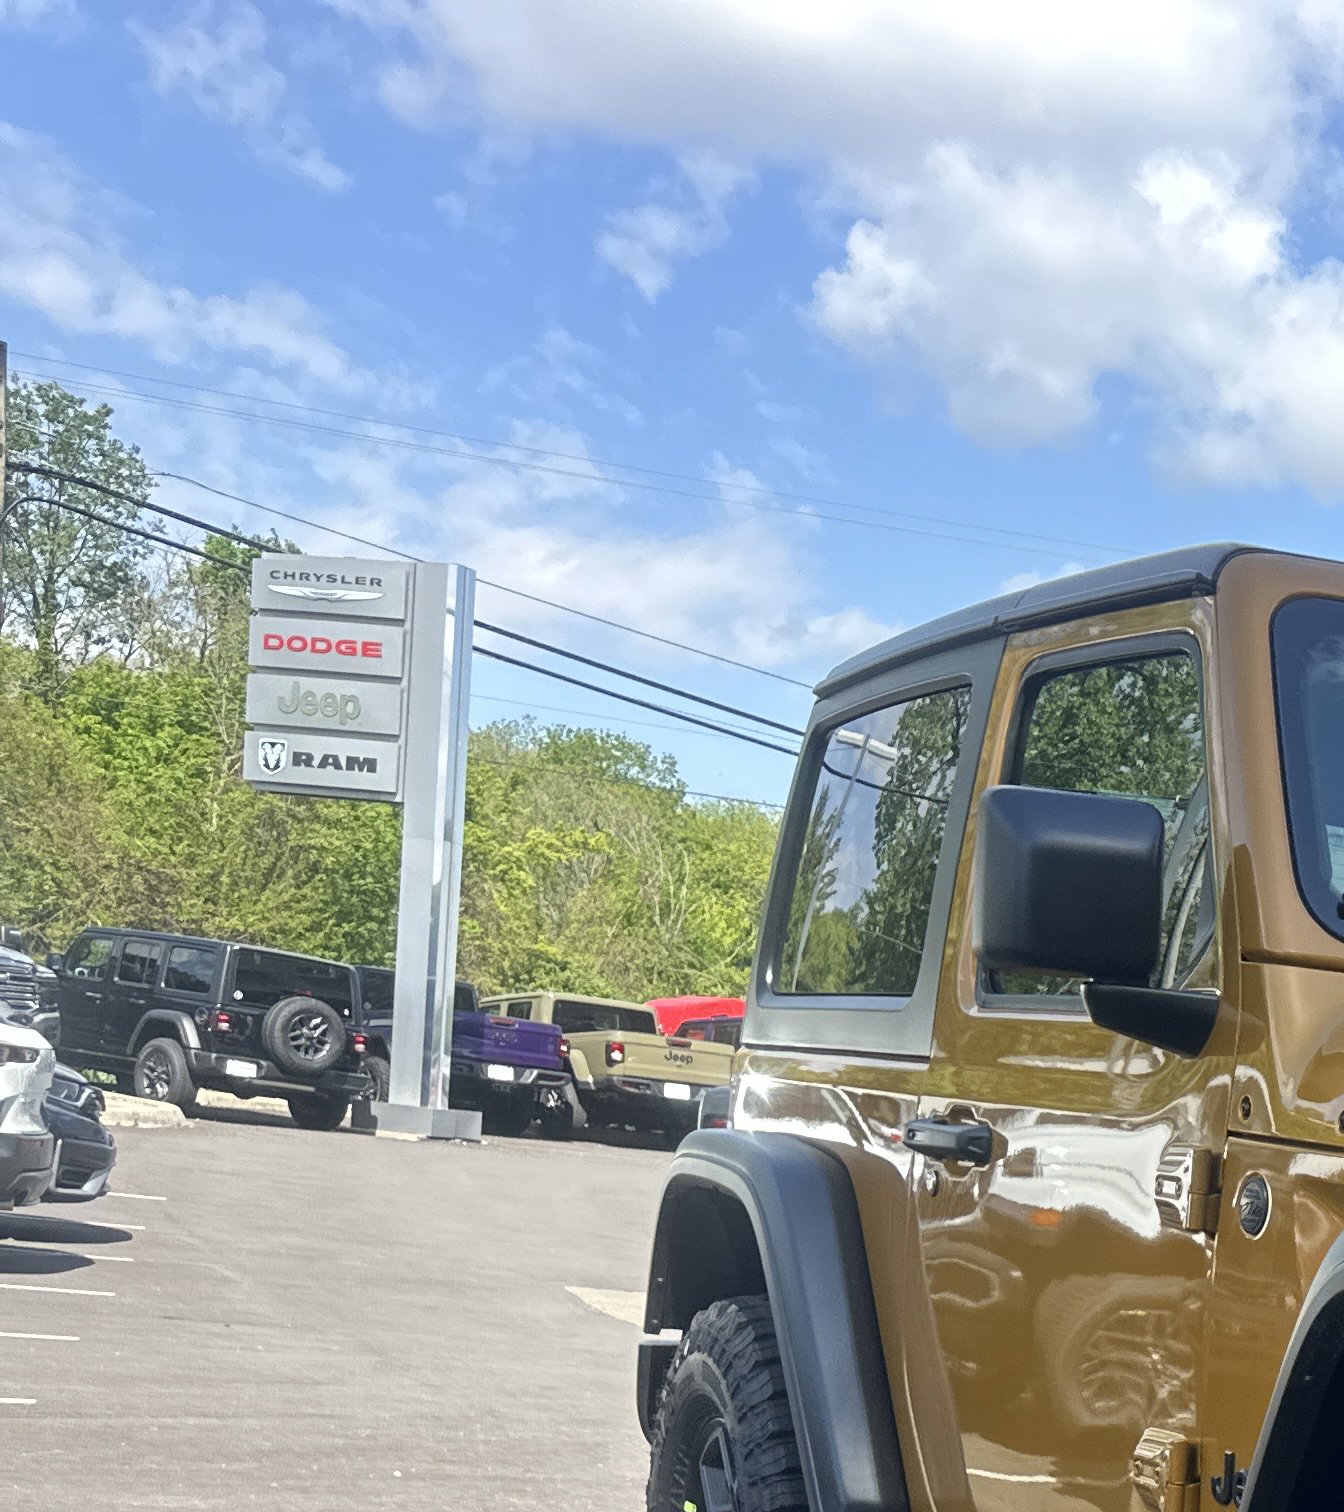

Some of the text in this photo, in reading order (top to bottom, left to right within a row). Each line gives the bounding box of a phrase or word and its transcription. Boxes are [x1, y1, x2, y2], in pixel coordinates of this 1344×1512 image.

[269, 569, 383, 588] CHRYSLER
[262, 633, 383, 659] DODGE
[277, 681, 362, 726] Jeep
[291, 751, 378, 774] RAM
[663, 1050, 694, 1066] Jeep
